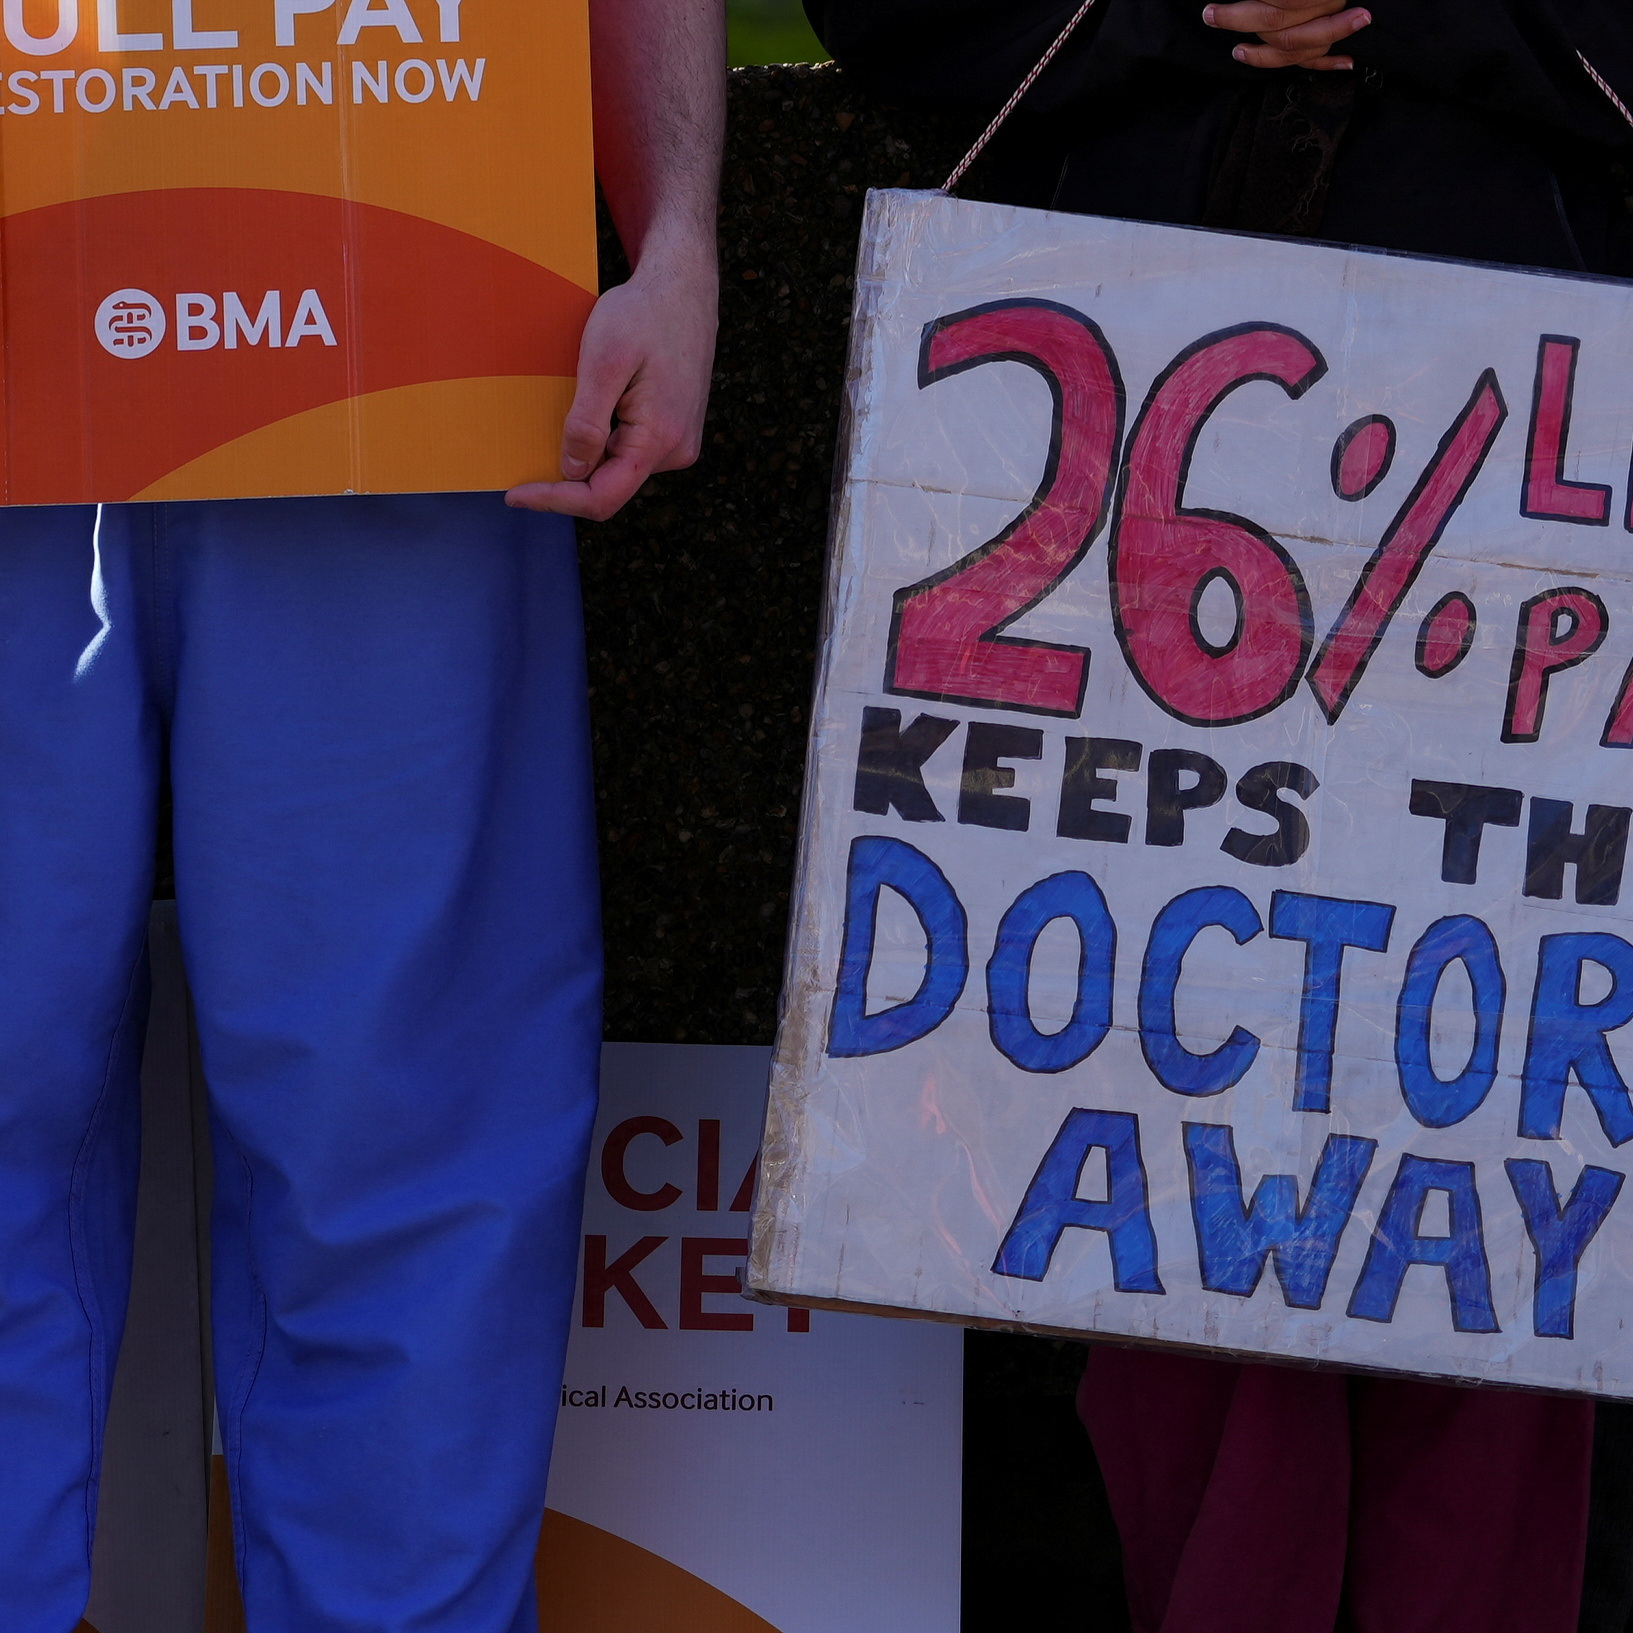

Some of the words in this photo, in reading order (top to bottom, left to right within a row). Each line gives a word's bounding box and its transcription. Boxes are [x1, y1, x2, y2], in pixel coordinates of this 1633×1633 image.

[352, 57, 486, 104] NOW
[177, 288, 338, 352] BMA
[884, 298, 1508, 728] 26%
[853, 707, 1321, 867] KEEPS
[601, 1115, 759, 1212] CI
[991, 1107, 1625, 1339] AWAY
[581, 1234, 810, 1333] KE
[561, 1384, 606, 1408] ical
[613, 1385, 773, 1411] Association
